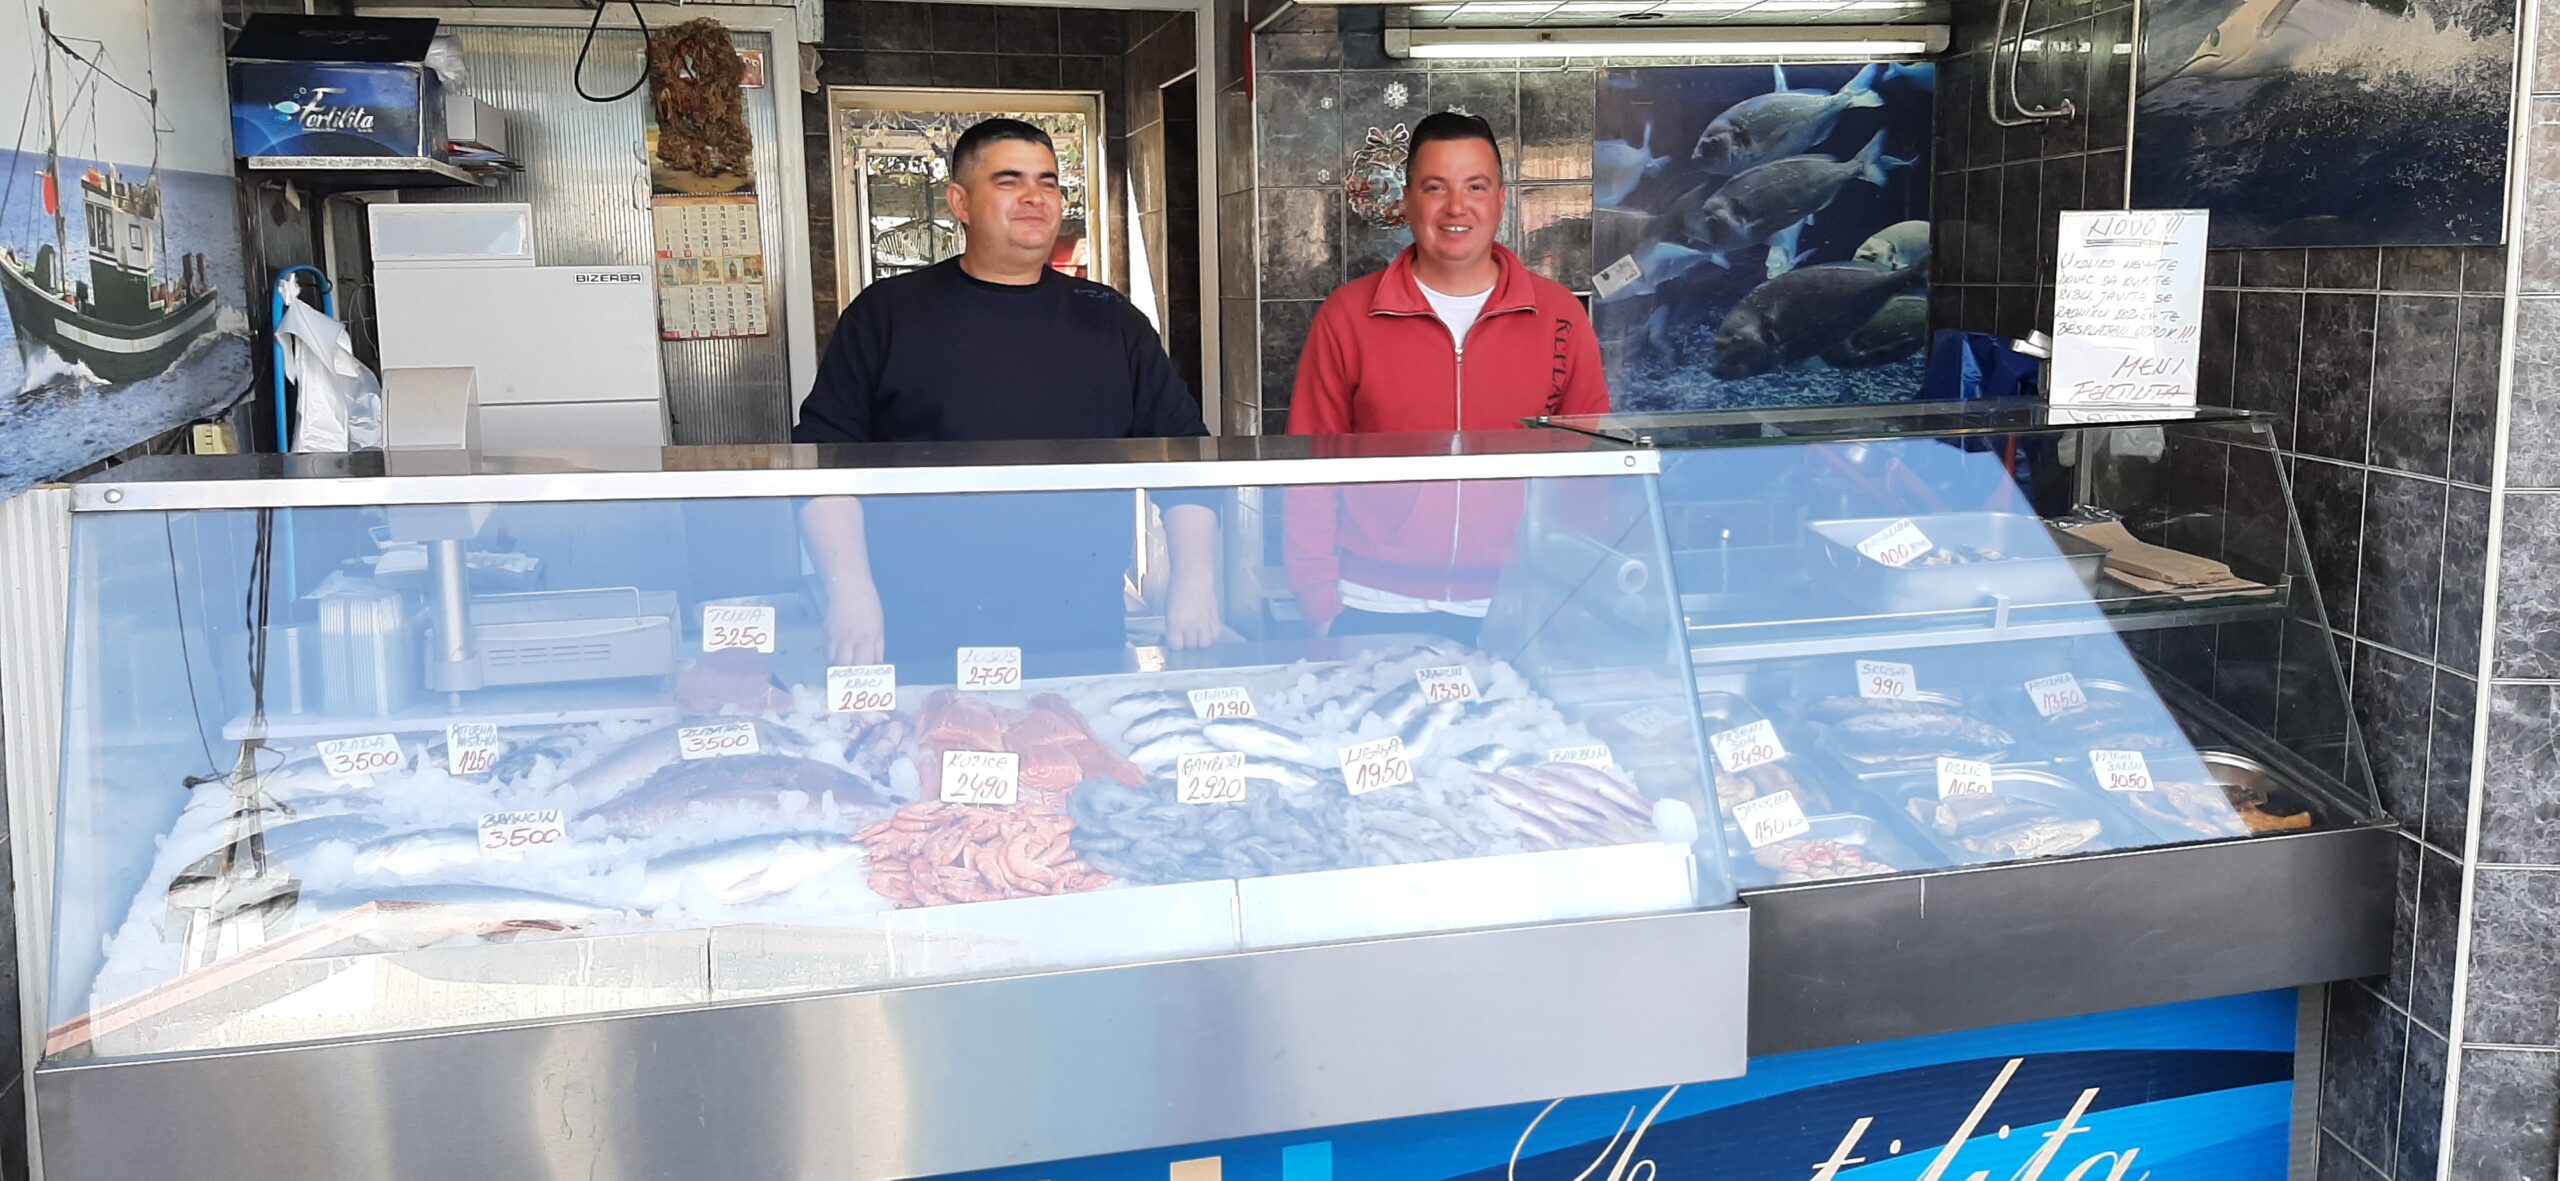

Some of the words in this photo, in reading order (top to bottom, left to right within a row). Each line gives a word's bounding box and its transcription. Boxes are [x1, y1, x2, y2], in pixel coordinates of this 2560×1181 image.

[299, 87, 375, 128] Fertilita
[2087, 216, 2157, 237] NOVO
[576, 273, 641, 283] BIZERBA
[2153, 294, 2174, 303] SE
[2111, 354, 2185, 378] MENI
[2068, 380, 2193, 403] FERTILITA
[708, 607, 766, 623] TUNA
[708, 626, 768, 647] 3250
[965, 665, 1019, 687] 2750
[1871, 676, 1905, 698] 990
[838, 690, 894, 712] 2800
[1430, 682, 1472, 701] 1390
[2042, 689, 2080, 714] 1350
[1206, 700, 1251, 719] 1290
[686, 733, 750, 753] 3500
[333, 750, 400, 774] 3500
[458, 748, 497, 776] 1250
[948, 753, 1008, 770] KOZICE
[1730, 743, 1775, 771] 2490
[1355, 756, 1408, 792] 1950
[2110, 772, 2148, 790] 2050
[949, 772, 1009, 802] 2490
[1187, 775, 1242, 801] 2920
[484, 827, 562, 849] 3500
